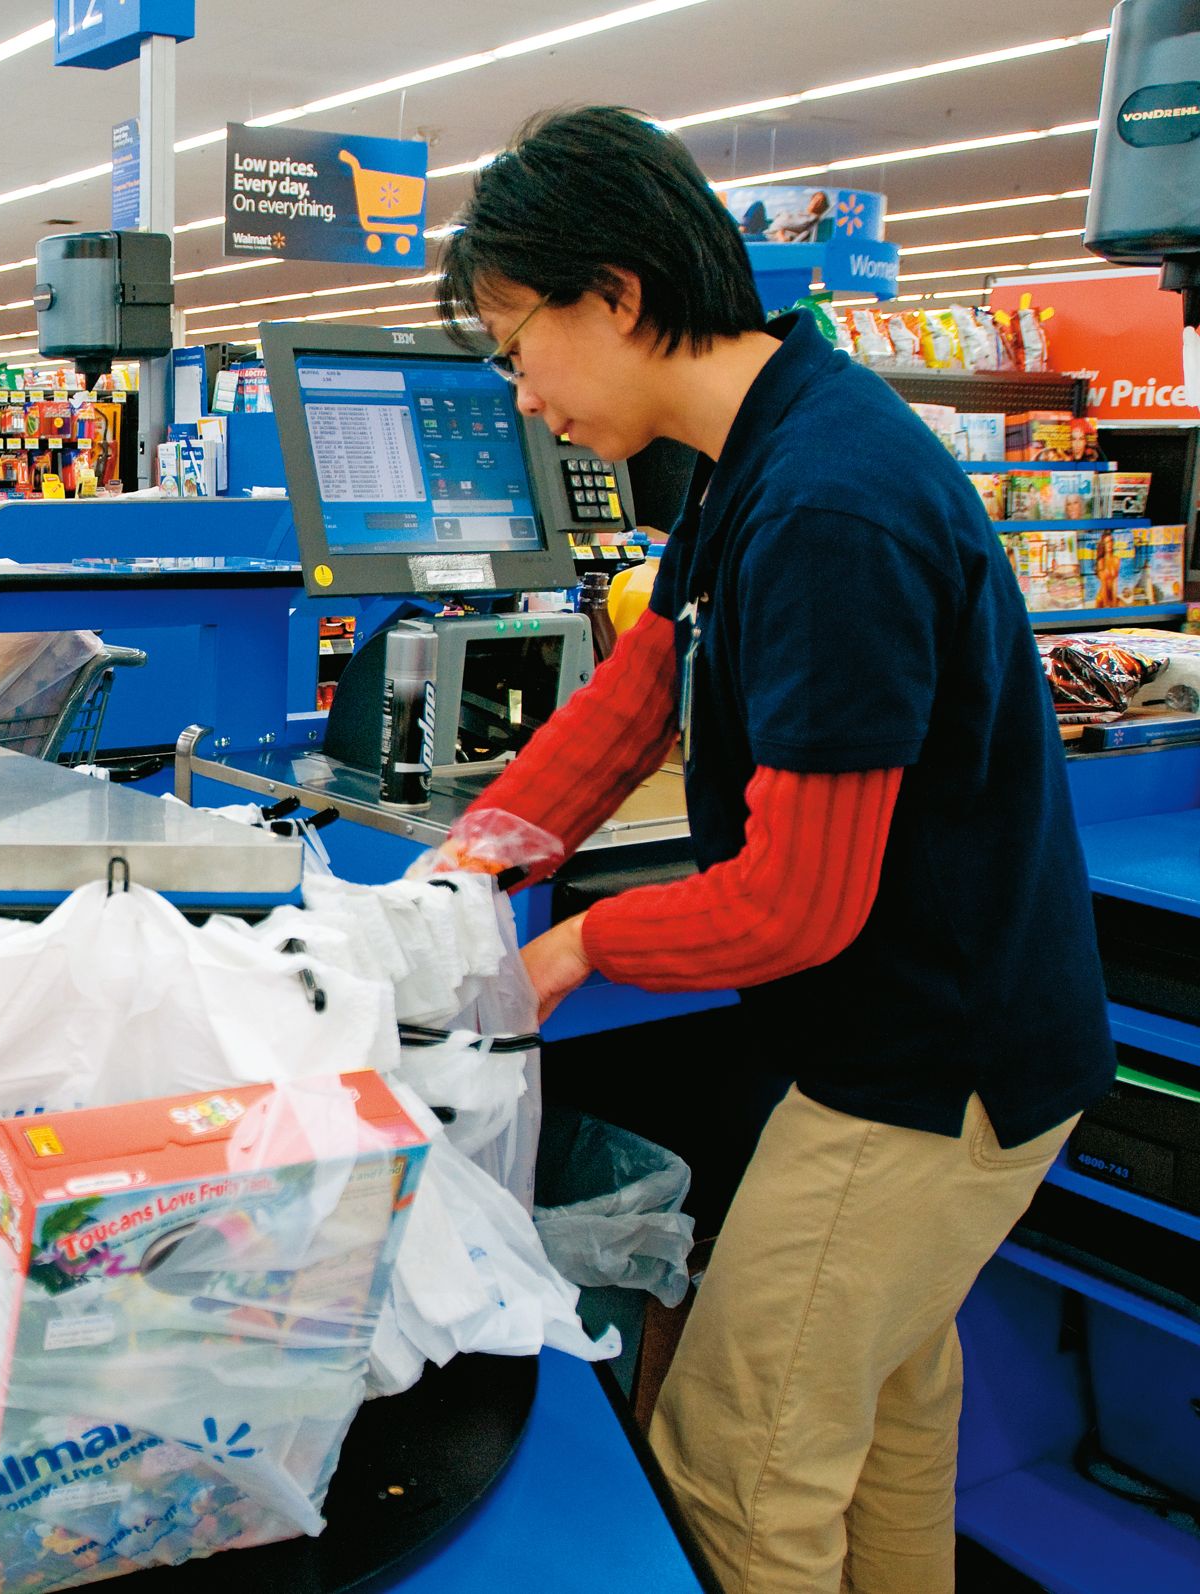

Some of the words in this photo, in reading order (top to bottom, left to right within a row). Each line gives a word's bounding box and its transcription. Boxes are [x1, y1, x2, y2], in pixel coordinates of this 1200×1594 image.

[1123, 106, 1200, 122] VONDREHL
[234, 153, 266, 173] Low
[269, 157, 318, 178] prices.
[234, 174, 277, 197] Every
[279, 177, 311, 199] day.
[233, 194, 256, 212] On
[258, 199, 337, 223] everything.
[233, 232, 272, 246] Walmart
[849, 254, 898, 278] Wome
[392, 332, 416, 345] IBM
[244, 369, 267, 377] LOCTIT
[1110, 377, 1186, 407] Price
[1078, 1153, 1129, 1178] 4800-743
[56, 1204, 153, 1262] Toucans
[157, 1190, 197, 1216] Love
[200, 1179, 238, 1202] Fruity
[60, 1464, 104, 1486] Live
